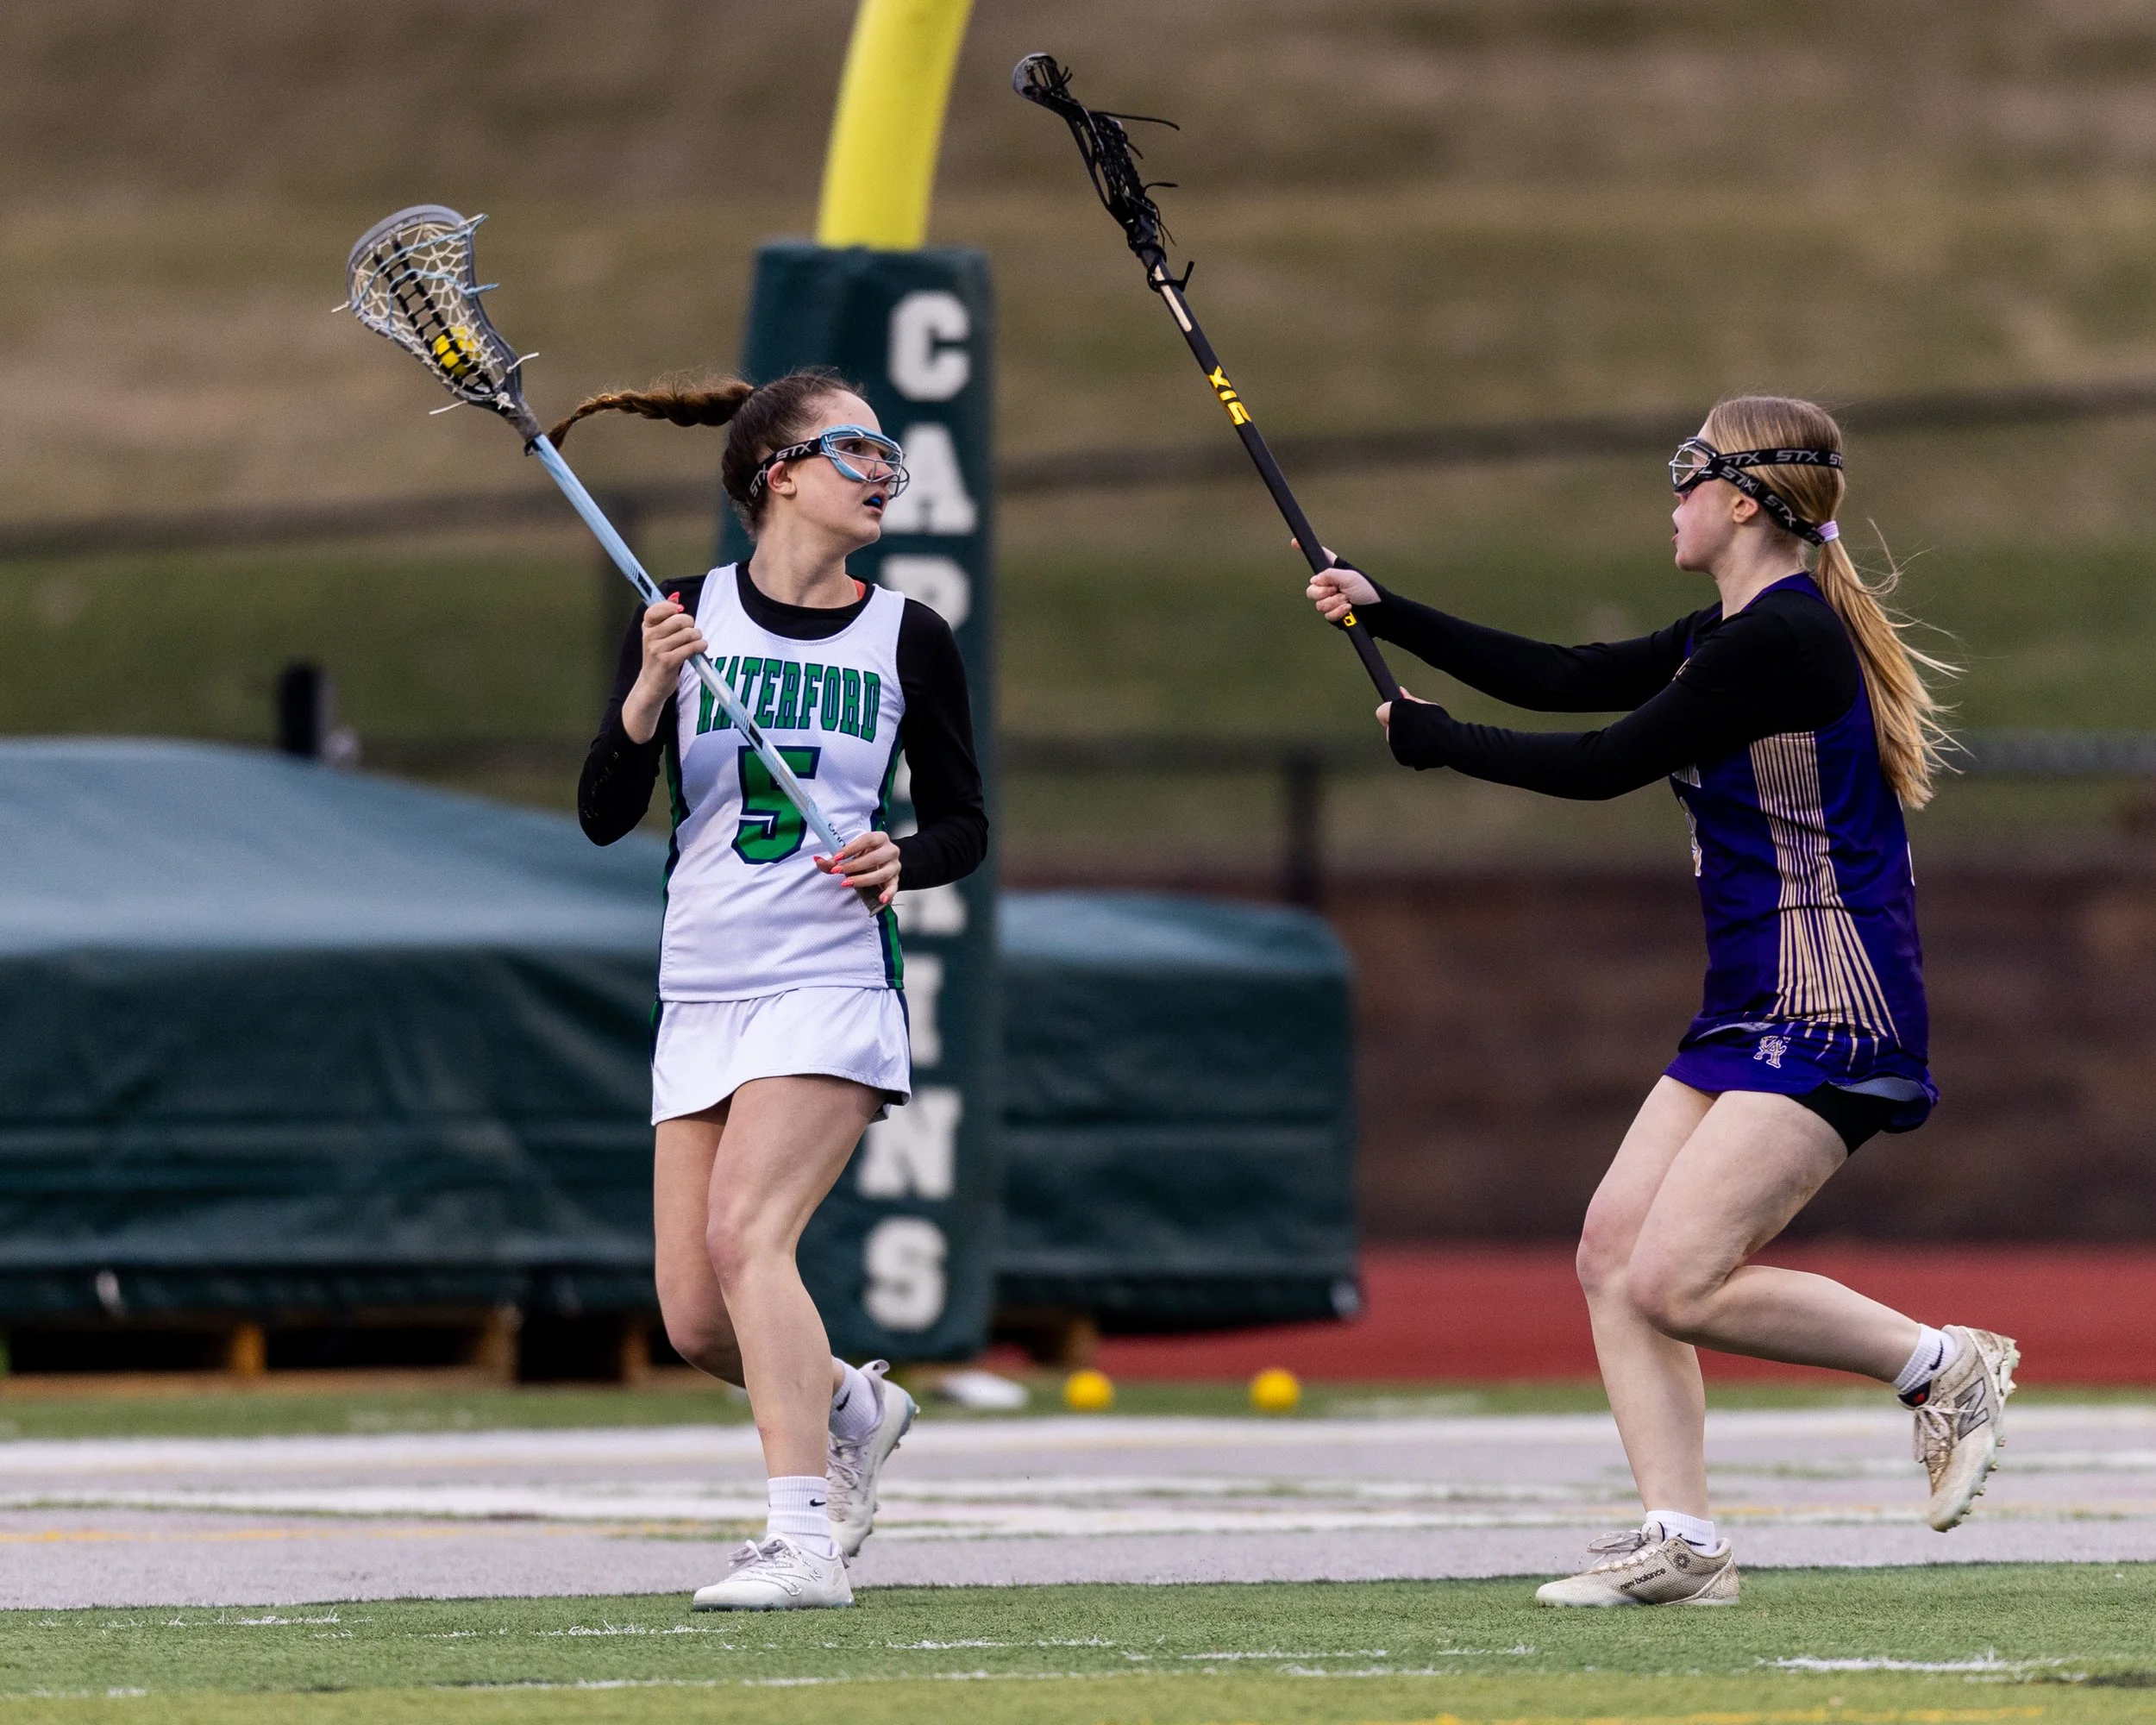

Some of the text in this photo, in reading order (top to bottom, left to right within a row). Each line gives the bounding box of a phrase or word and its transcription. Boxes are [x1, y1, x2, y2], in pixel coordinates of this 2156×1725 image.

[776, 442, 812, 461] STX
[1775, 449, 1819, 463] STX
[749, 463, 768, 498] STX
[1720, 465, 1757, 492] STX
[1764, 493, 1797, 527] STX
[696, 656, 881, 743] WATERFORD
[730, 745, 822, 865] 5
[1620, 1567, 1666, 1590] new balance
